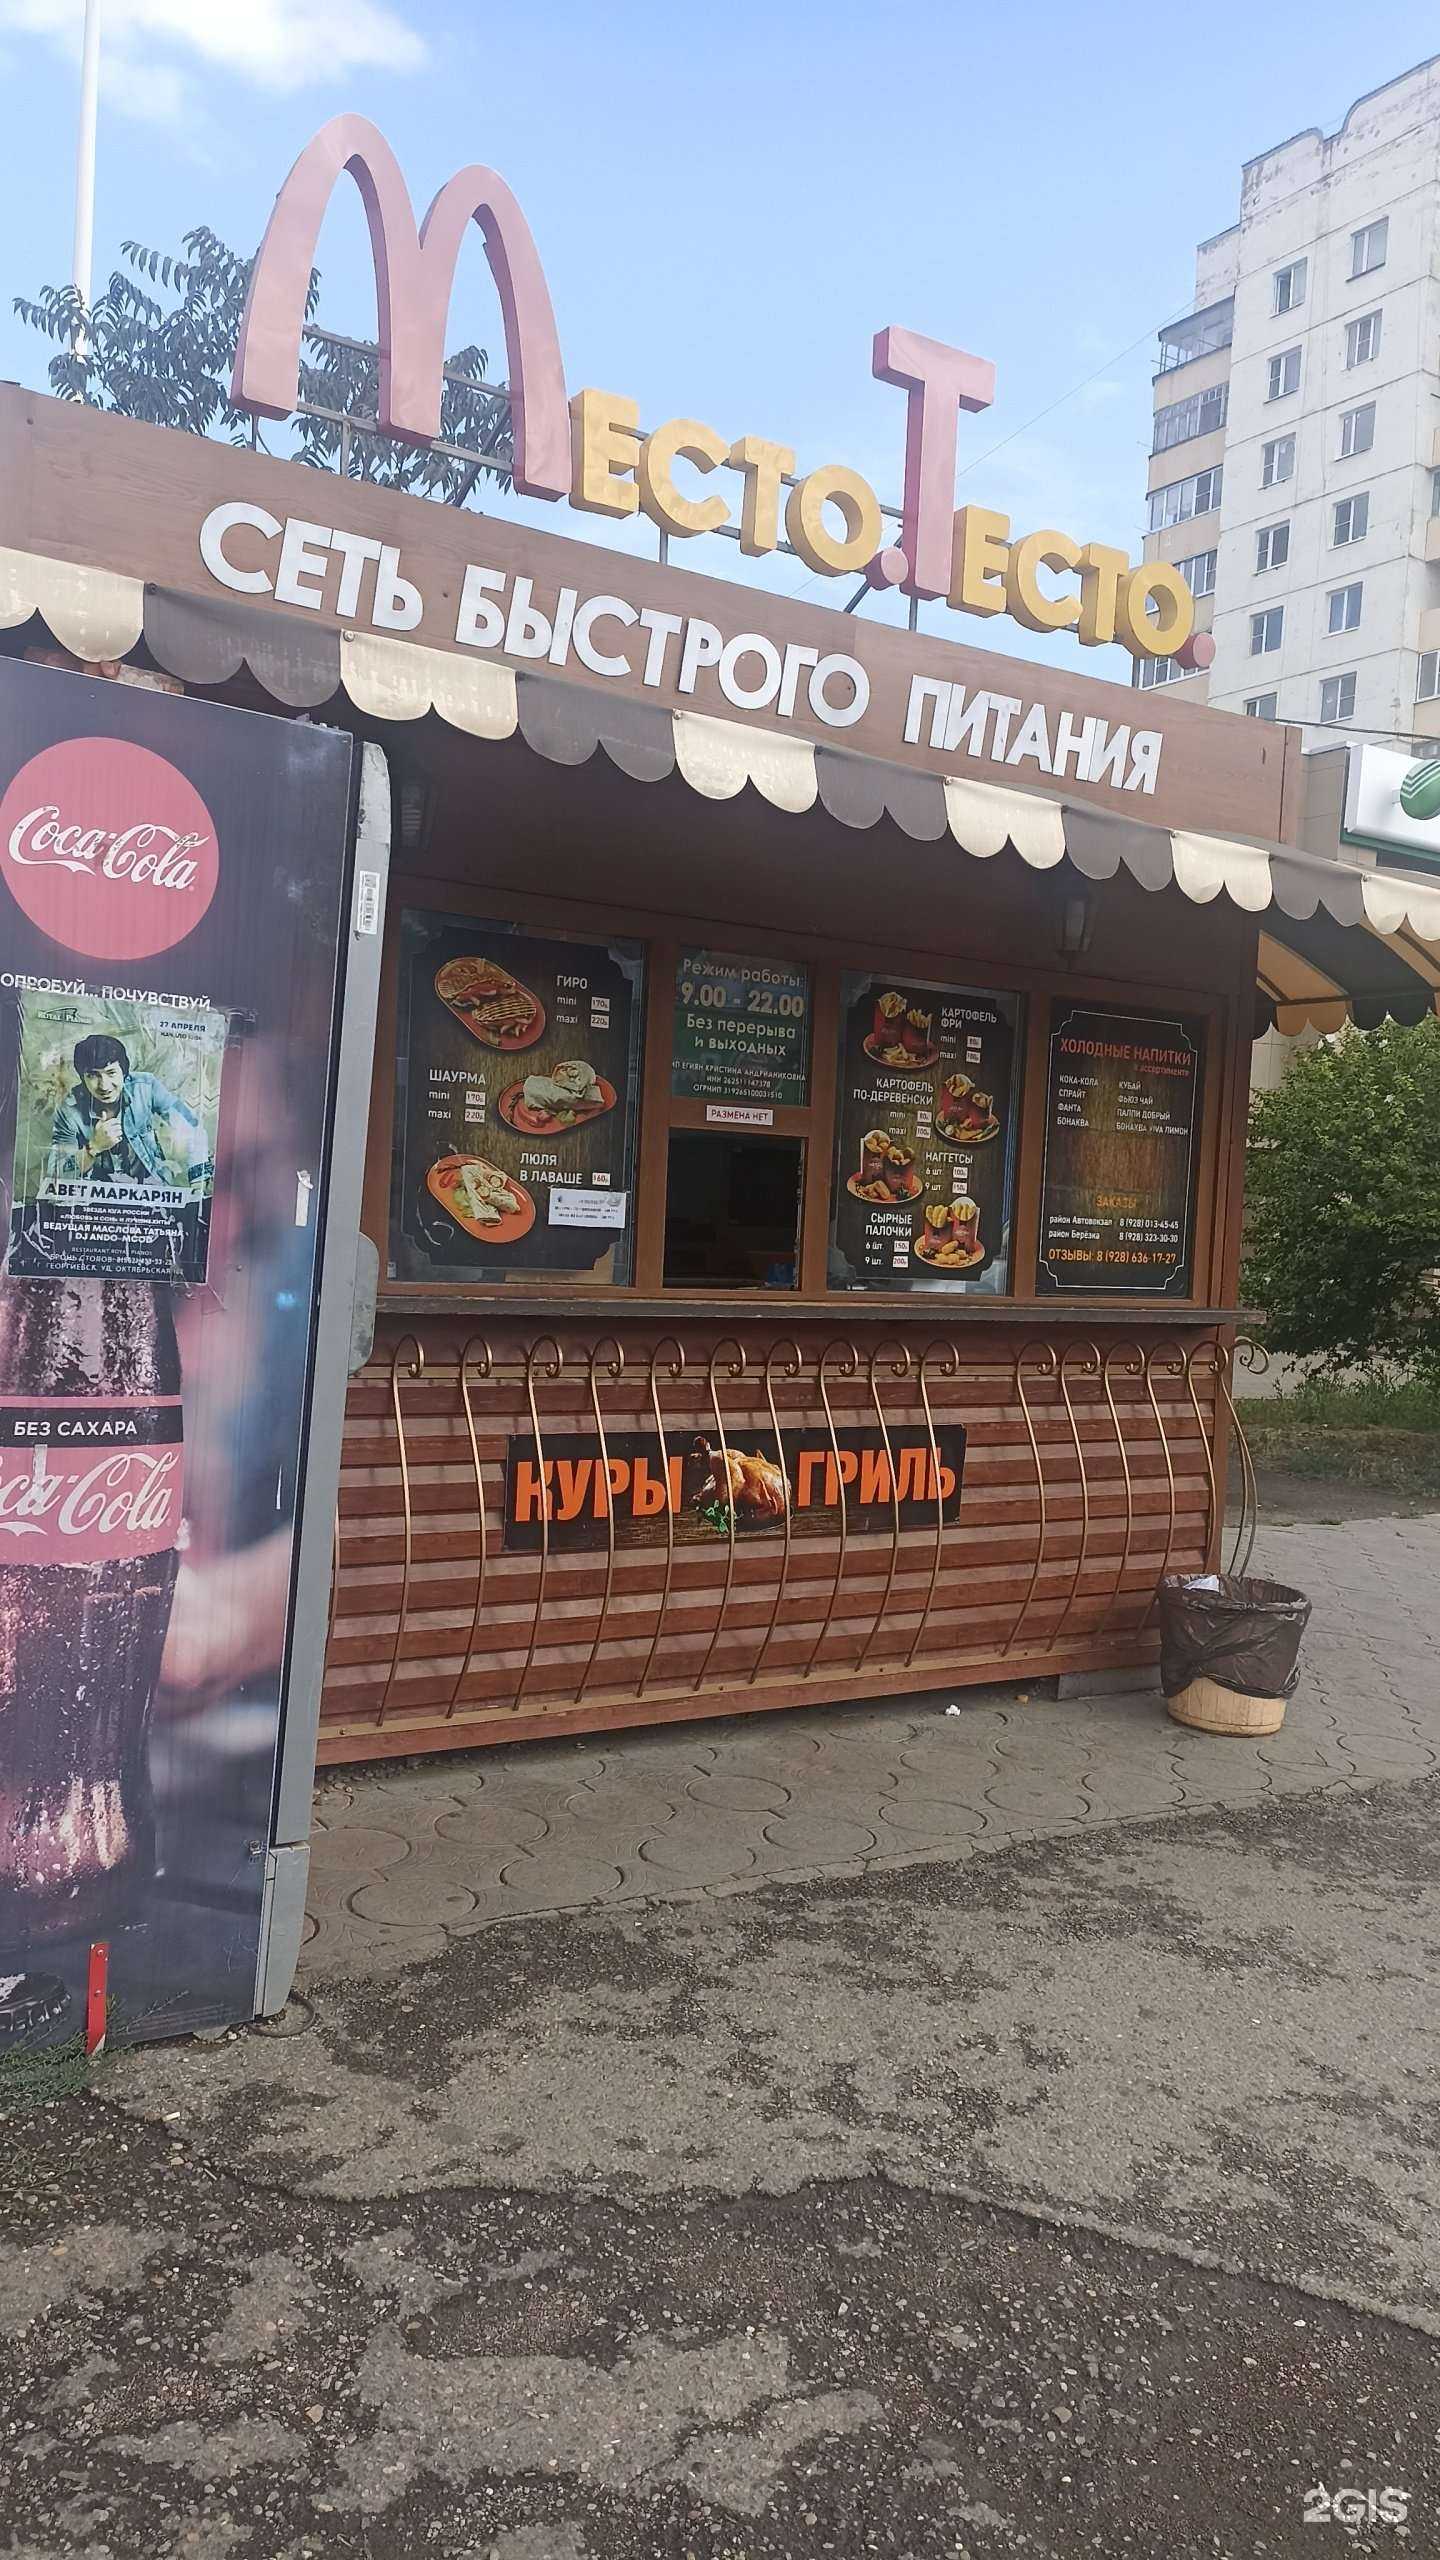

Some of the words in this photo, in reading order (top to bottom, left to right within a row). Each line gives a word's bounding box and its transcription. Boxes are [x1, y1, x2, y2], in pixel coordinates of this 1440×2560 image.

[199, 501, 424, 632] СЕТЬ
[456, 564, 871, 728] БЫСТРОГО
[903, 674, 1163, 795] ПИТАНИЯ
[8, 805, 209, 890] Coca-Cola
[683, 958, 737, 978] Режим
[556, 975, 588, 990] ГИРО
[101, 985, 211, 1012] ПОЧУВСТВУЙ
[556, 995, 577, 1006] mini
[681, 981, 727, 1008] 9.00
[747, 989, 805, 1018] 22.00
[556, 1015, 578, 1024] maxi
[941, 1008, 998, 1024] КАРТОФЕЛЬ
[171, 1022, 206, 1033] АПРЕЛЯ
[687, 1013, 713, 1030] Без
[717, 1019, 796, 1040] перерыва
[941, 1018, 962, 1029] ФРИ
[941, 1034, 957, 1044] mini
[709, 1038, 786, 1056] выходных
[1060, 1038, 1131, 1060] ХОЛОДНЫЕ
[1133, 1046, 1191, 1065] НАПИТКИ
[705, 1062, 743, 1075] КРИСТИНА
[429, 1069, 486, 1085] ШАУРМА
[706, 1075, 722, 1083] ИНН
[1059, 1074, 1098, 1087] КОКА-КОЛА
[692, 1085, 722, 1094] ОГРНИП
[876, 1078, 934, 1093] КАРТОФЕЛЬ
[1119, 1081, 1142, 1091] КУБАЙ
[428, 1090, 450, 1100] mini
[853, 1088, 933, 1105] ПО-ДЕРЕВЕНСКИ
[1059, 1088, 1087, 1099] СПРАЙТ
[1140, 1096, 1153, 1106] ЧАЙ
[1057, 1103, 1082, 1113] ФАНТА
[428, 1110, 451, 1119] maxi
[711, 1109, 750, 1121] РАЗМЕНА
[751, 1112, 768, 1121] НЕТ
[889, 1111, 906, 1119] mini
[1141, 1110, 1171, 1121] ДОБРЫЙ
[1057, 1116, 1089, 1128] БОНАКВА
[888, 1127, 907, 1135] maxi
[1164, 1126, 1189, 1136] ЛИМОН
[520, 1153, 557, 1166] ЛЮЛЯ
[925, 1152, 973, 1164] НАГГЕТСЫ
[520, 1170, 528, 1181] В
[530, 1170, 583, 1184] ЛАВАШЕ
[925, 1167, 931, 1175] 6
[925, 1182, 930, 1190] 9
[45, 1183, 88, 1197] АВЕТ
[90, 1185, 183, 1203] МАРКАРЯН
[1096, 1195, 1136, 1209] ЗАКАЗЫ
[870, 1212, 913, 1225] СЫРНЫЕ
[1049, 1215, 1070, 1225] район
[1120, 1218, 1124, 1227] 8
[1125, 1218, 1144, 1228] (928)
[43, 1221, 91, 1232] ВЕДУЩАЯ
[92, 1224, 142, 1235] МАСЛОВА
[144, 1227, 184, 1237] ТАТЬЯНА
[865, 1225, 912, 1237] ПАЛОЧКИ
[75, 1232, 88, 1241] DJ
[1048, 1230, 1069, 1240] район
[1119, 1232, 1124, 1241] 8
[1125, 1232, 1143, 1242] (928)
[1144, 1233, 1178, 1243] 323-30-30
[865, 1241, 871, 1250] 6
[865, 1256, 870, 1265] 9
[1096, 1250, 1103, 1261] 8
[1105, 1250, 1129, 1263] (928)
[1131, 1252, 1176, 1264] 636-17-27
[14, 1421, 51, 1436] БЕЗ
[57, 1420, 137, 1436] САХАРА
[514, 1456, 683, 1523] КУРЫ
[796, 1447, 957, 1508] ГРИЛЬ
